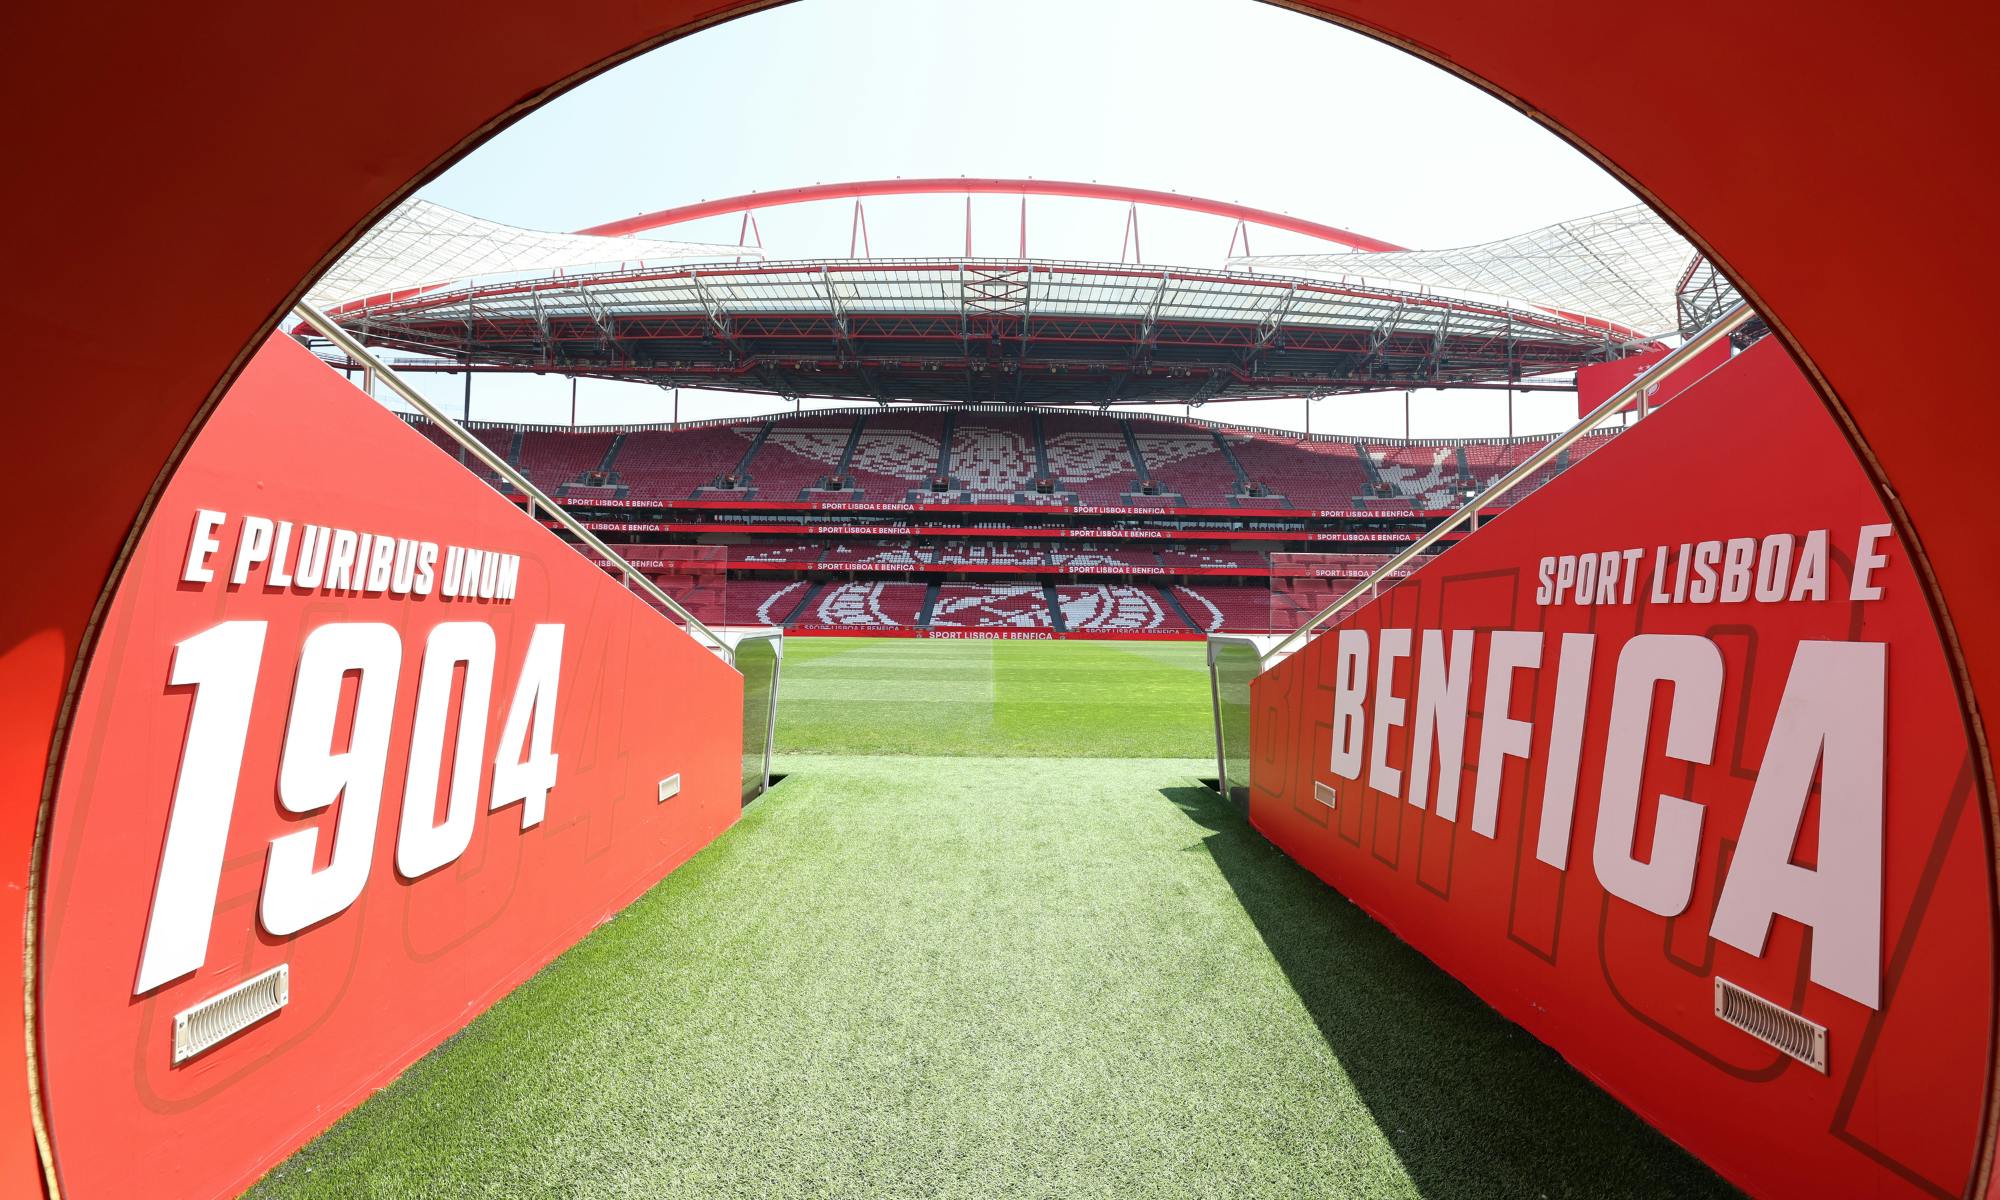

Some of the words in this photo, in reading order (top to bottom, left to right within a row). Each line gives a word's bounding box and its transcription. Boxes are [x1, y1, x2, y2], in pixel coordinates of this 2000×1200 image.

[592, 523, 620, 531] LISBOA
[629, 524, 659, 532] BENFICA
[596, 499, 623, 507] LISBOA
[632, 500, 663, 508] BENFICA
[180, 509, 226, 583] E
[230, 515, 439, 595] PLURIBUS
[440, 545, 521, 600] UNUM
[1536, 548, 1645, 606] SPORT
[1651, 529, 1829, 604] LISBOA
[1850, 523, 1893, 600] E
[133, 620, 565, 995] 1904
[1330, 628, 1890, 1010] BENFICA
